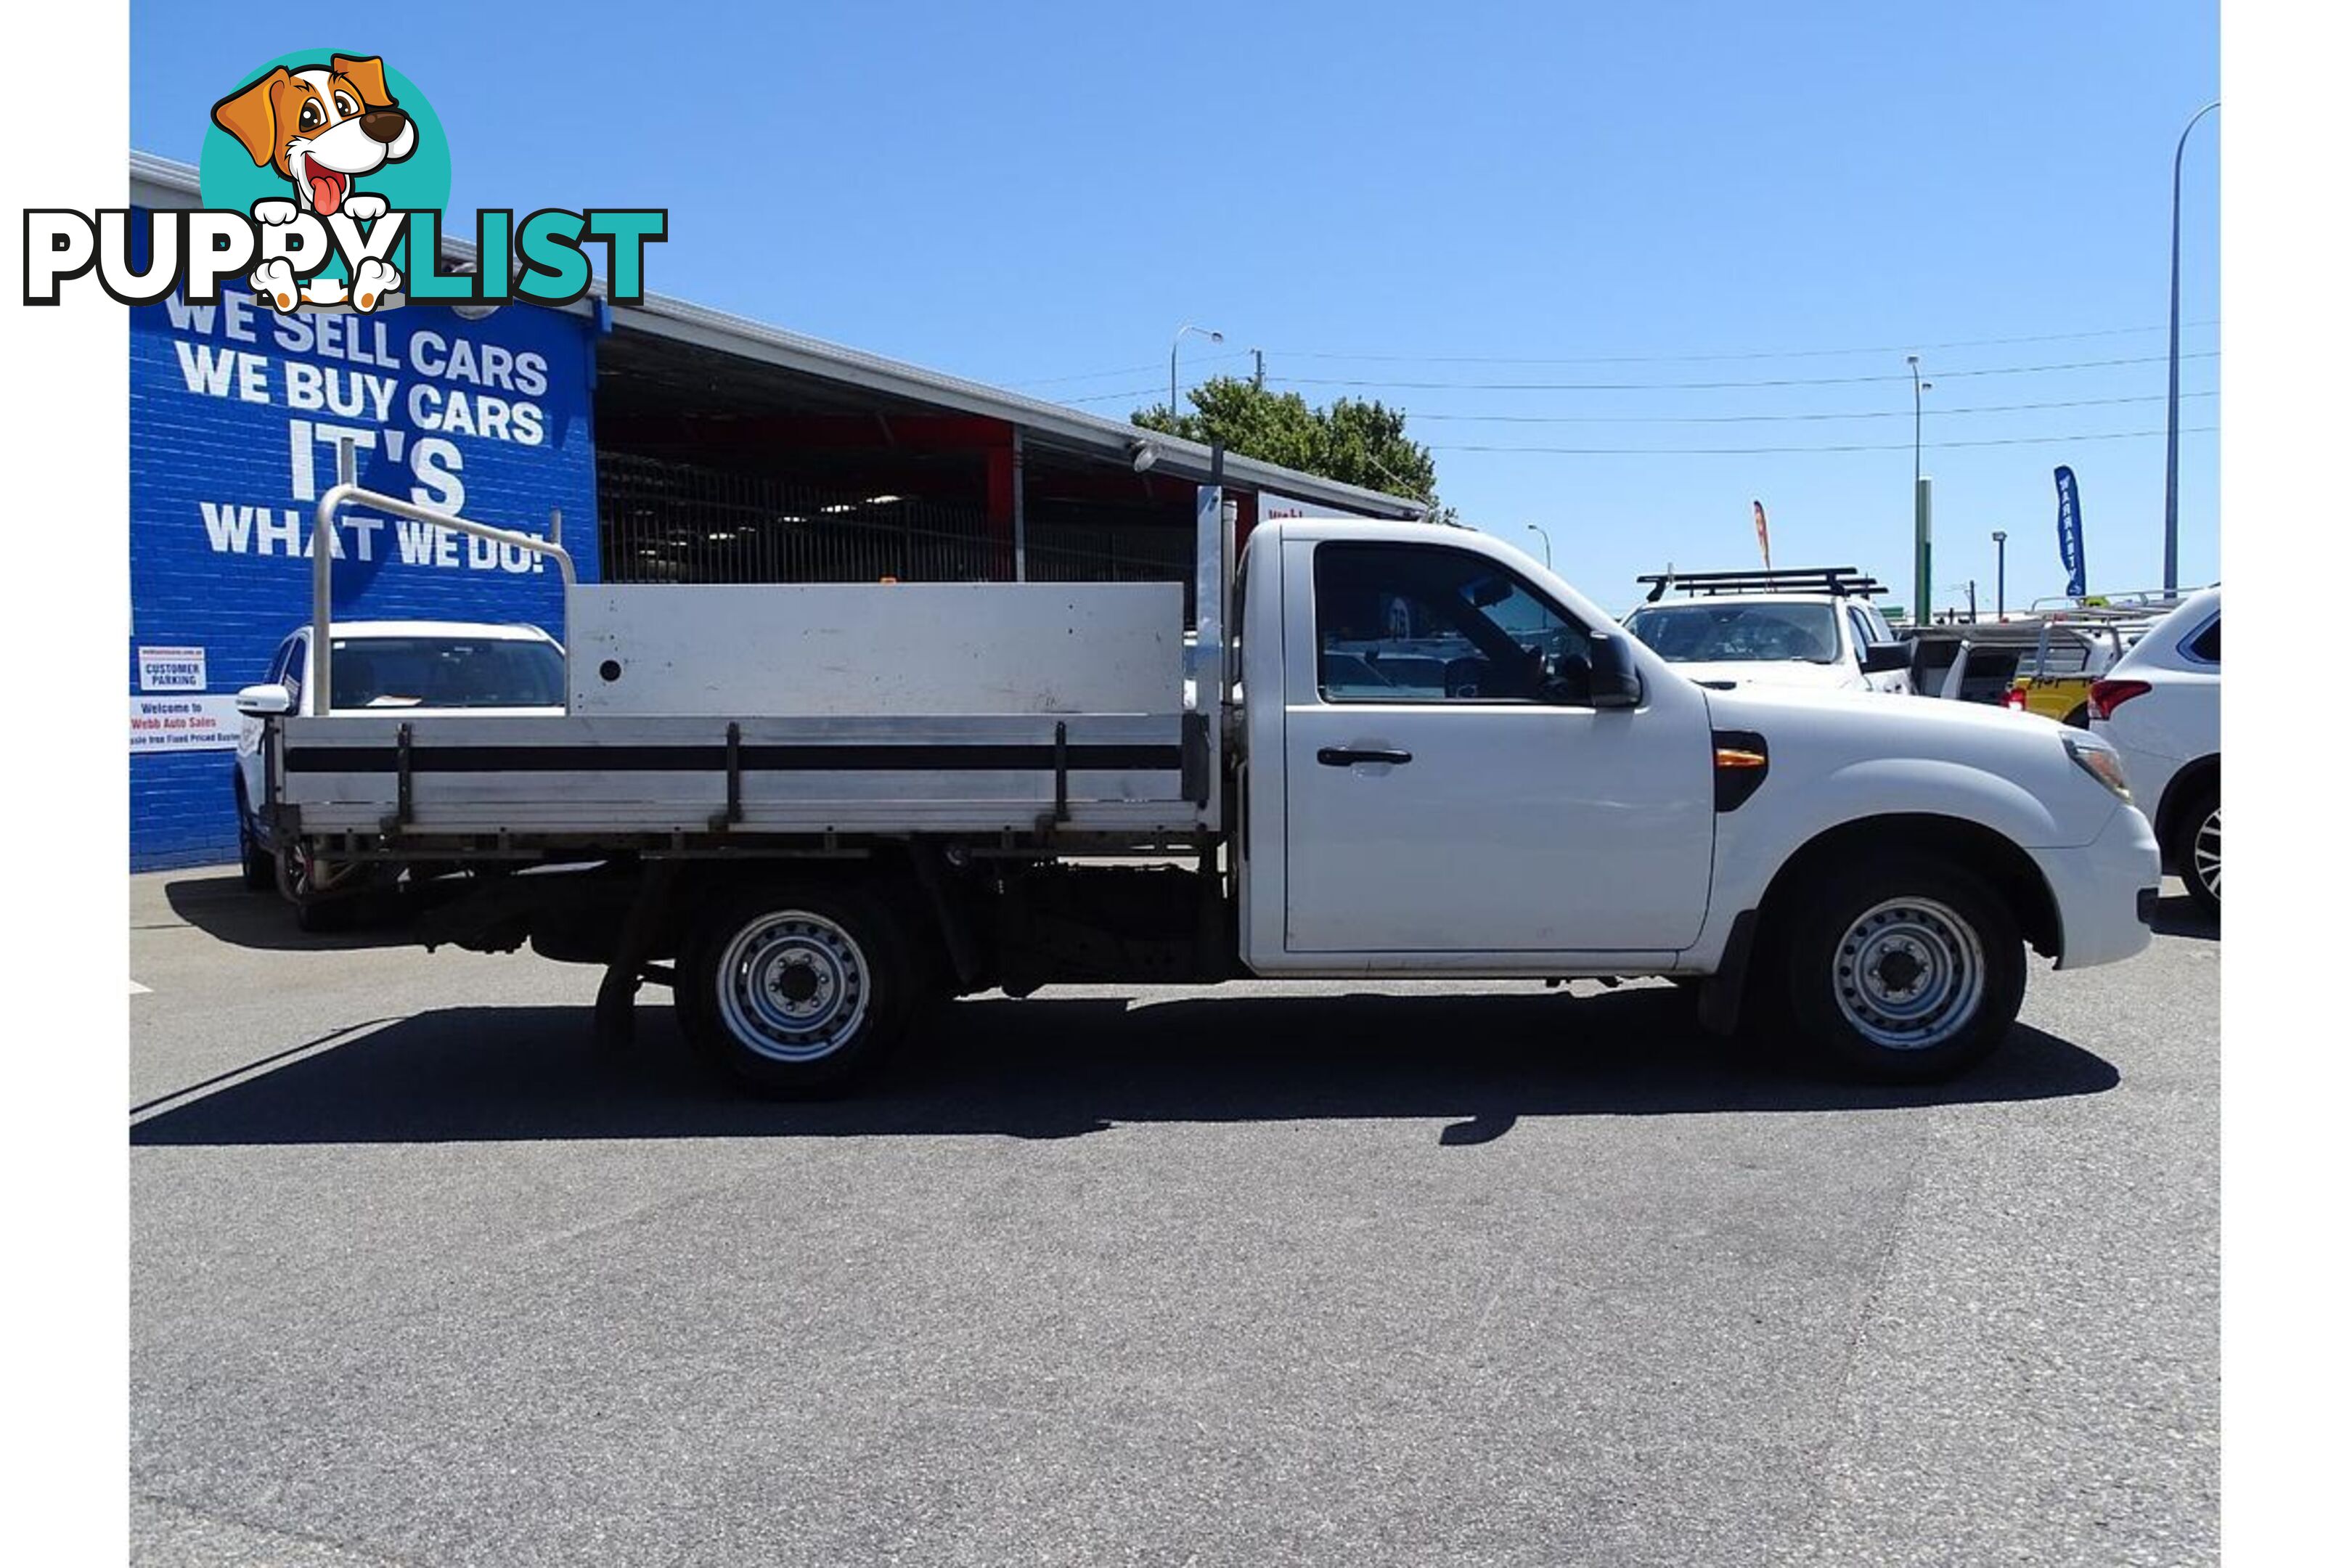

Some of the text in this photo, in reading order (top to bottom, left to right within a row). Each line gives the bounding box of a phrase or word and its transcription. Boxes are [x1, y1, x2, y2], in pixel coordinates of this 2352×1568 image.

[165, 288, 548, 397] WE SELL CARS
[173, 340, 544, 446] WE BUY CARS
[289, 419, 465, 516] IT'S
[200, 501, 544, 573] WHAT WE DO!
[147, 663, 200, 674] CUSTOMER
[152, 675, 197, 685] PARKING
[131, 716, 216, 730] Webb Auto Sales
[141, 703, 203, 714] Welcome to
